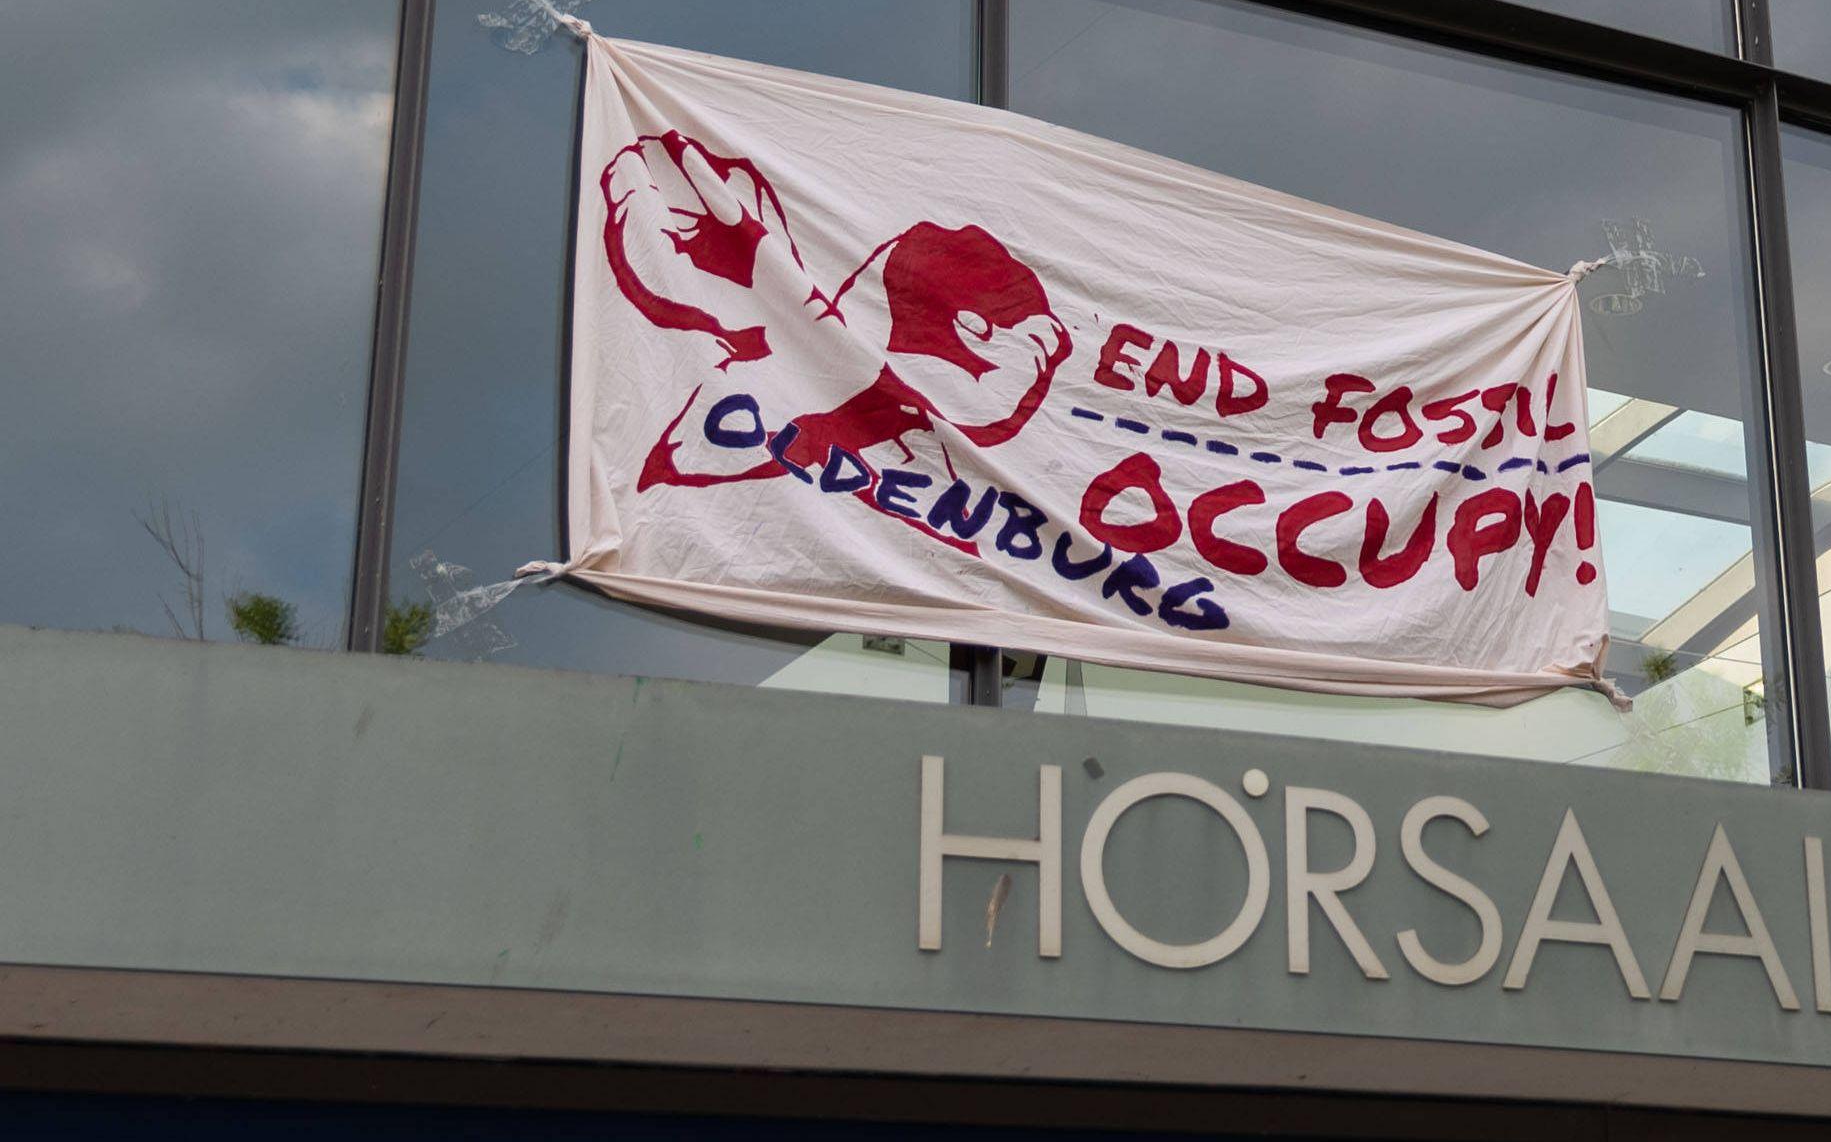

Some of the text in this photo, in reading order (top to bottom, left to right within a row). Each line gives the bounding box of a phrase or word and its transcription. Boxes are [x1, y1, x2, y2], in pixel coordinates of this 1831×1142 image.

[1094, 324, 1576, 452] END FOSSIL
[704, 394, 1230, 631] OLDENBURG
[1079, 452, 1597, 598] OCCUPY!
